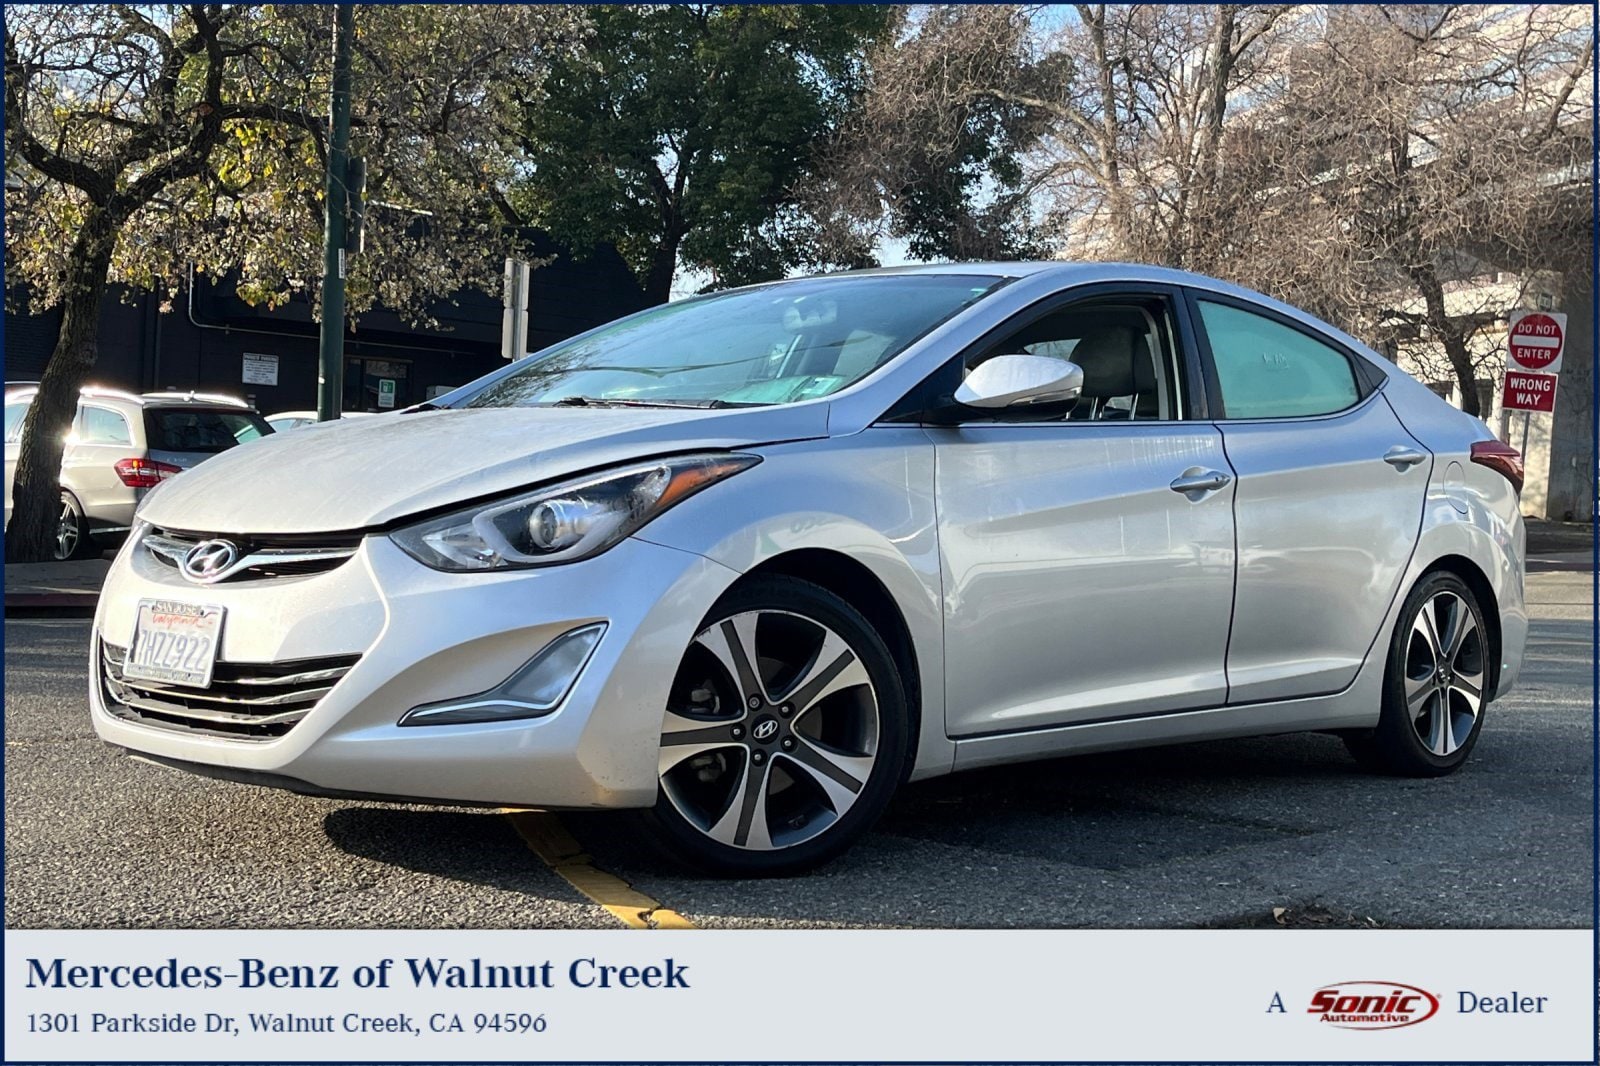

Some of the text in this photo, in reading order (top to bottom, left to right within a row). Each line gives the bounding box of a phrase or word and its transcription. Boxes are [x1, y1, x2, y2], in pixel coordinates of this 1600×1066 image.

[1518, 324, 1557, 335] DO NOT
[1517, 348, 1551, 360] ENTER
[1510, 378, 1551, 392] WRONG
[1516, 392, 1541, 405] WAY
[156, 601, 199, 615] SAN JOSE
[137, 629, 210, 672] 7HZZ922
